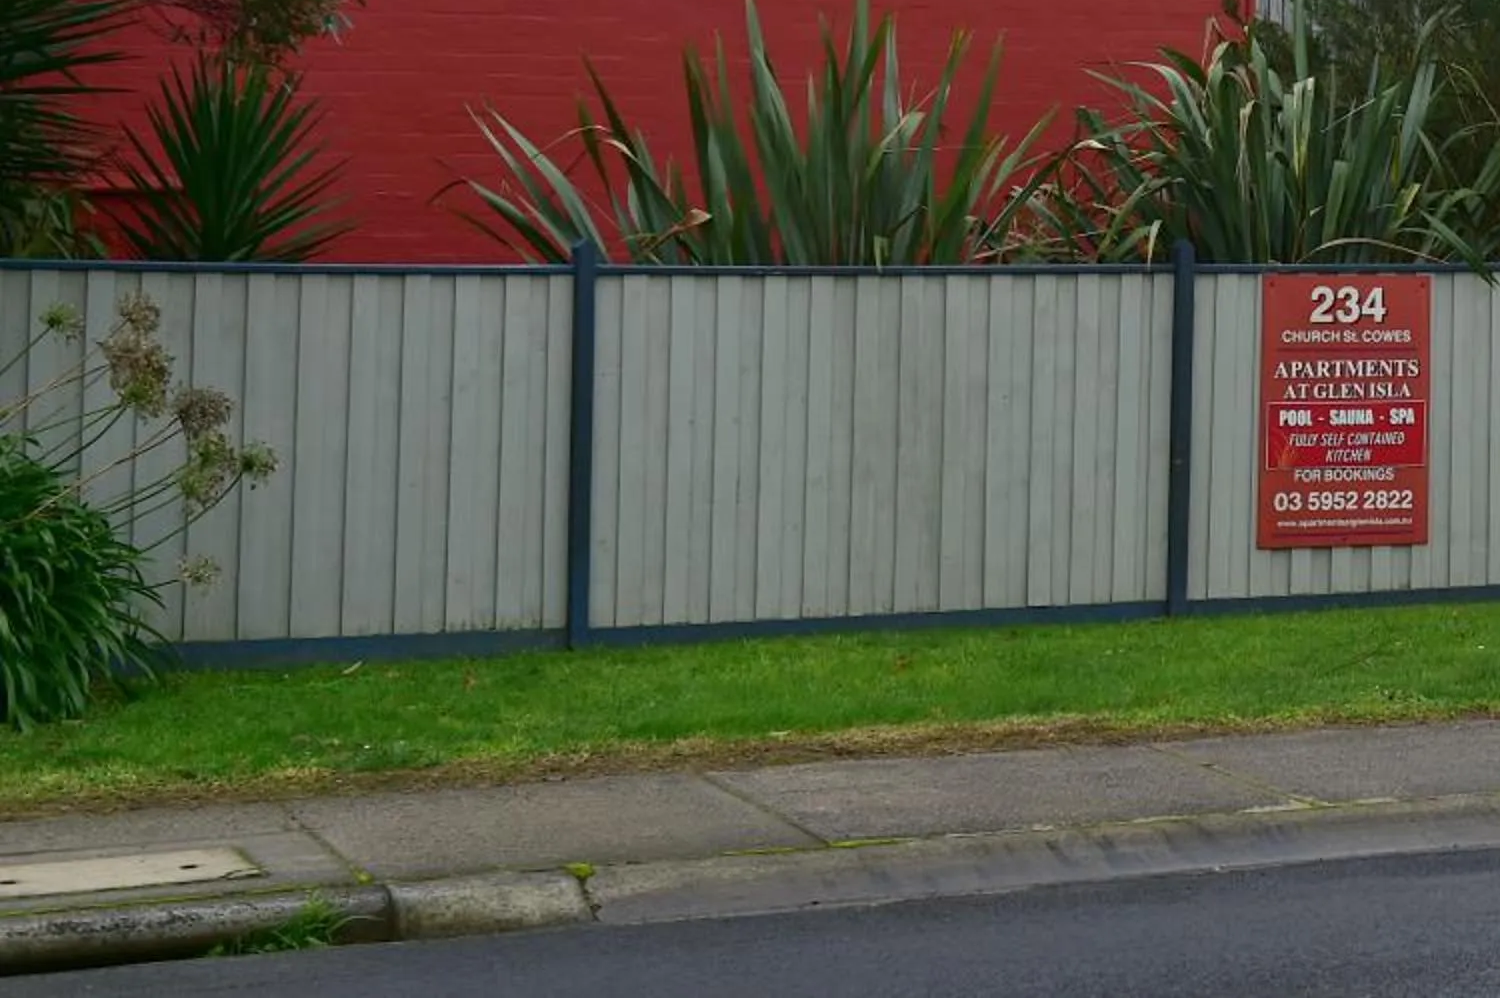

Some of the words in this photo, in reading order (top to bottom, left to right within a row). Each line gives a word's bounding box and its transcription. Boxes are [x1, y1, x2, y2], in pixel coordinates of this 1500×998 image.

[1309, 285, 1388, 323] 234
[1281, 330, 1340, 343] CHURCH
[1362, 329, 1412, 343] COWES
[1274, 359, 1420, 379] APARTMENTS
[1283, 383, 1310, 399] AT
[1313, 382, 1365, 399] GLEN
[1369, 381, 1411, 398] ISLA
[1279, 409, 1313, 427] POOL
[1329, 408, 1375, 426] SAUNA
[1389, 407, 1415, 425] SPA
[1288, 433, 1318, 447] FULLY
[1319, 432, 1344, 446] SELF
[1346, 431, 1405, 445] CONTAINED
[1325, 449, 1372, 463] KITCHEN
[1294, 469, 1321, 483] FOR
[1323, 467, 1396, 482] BOOKINGS
[1273, 492, 1302, 512] 03
[1307, 491, 1359, 511] 5952
[1363, 489, 1413, 509] 2822
